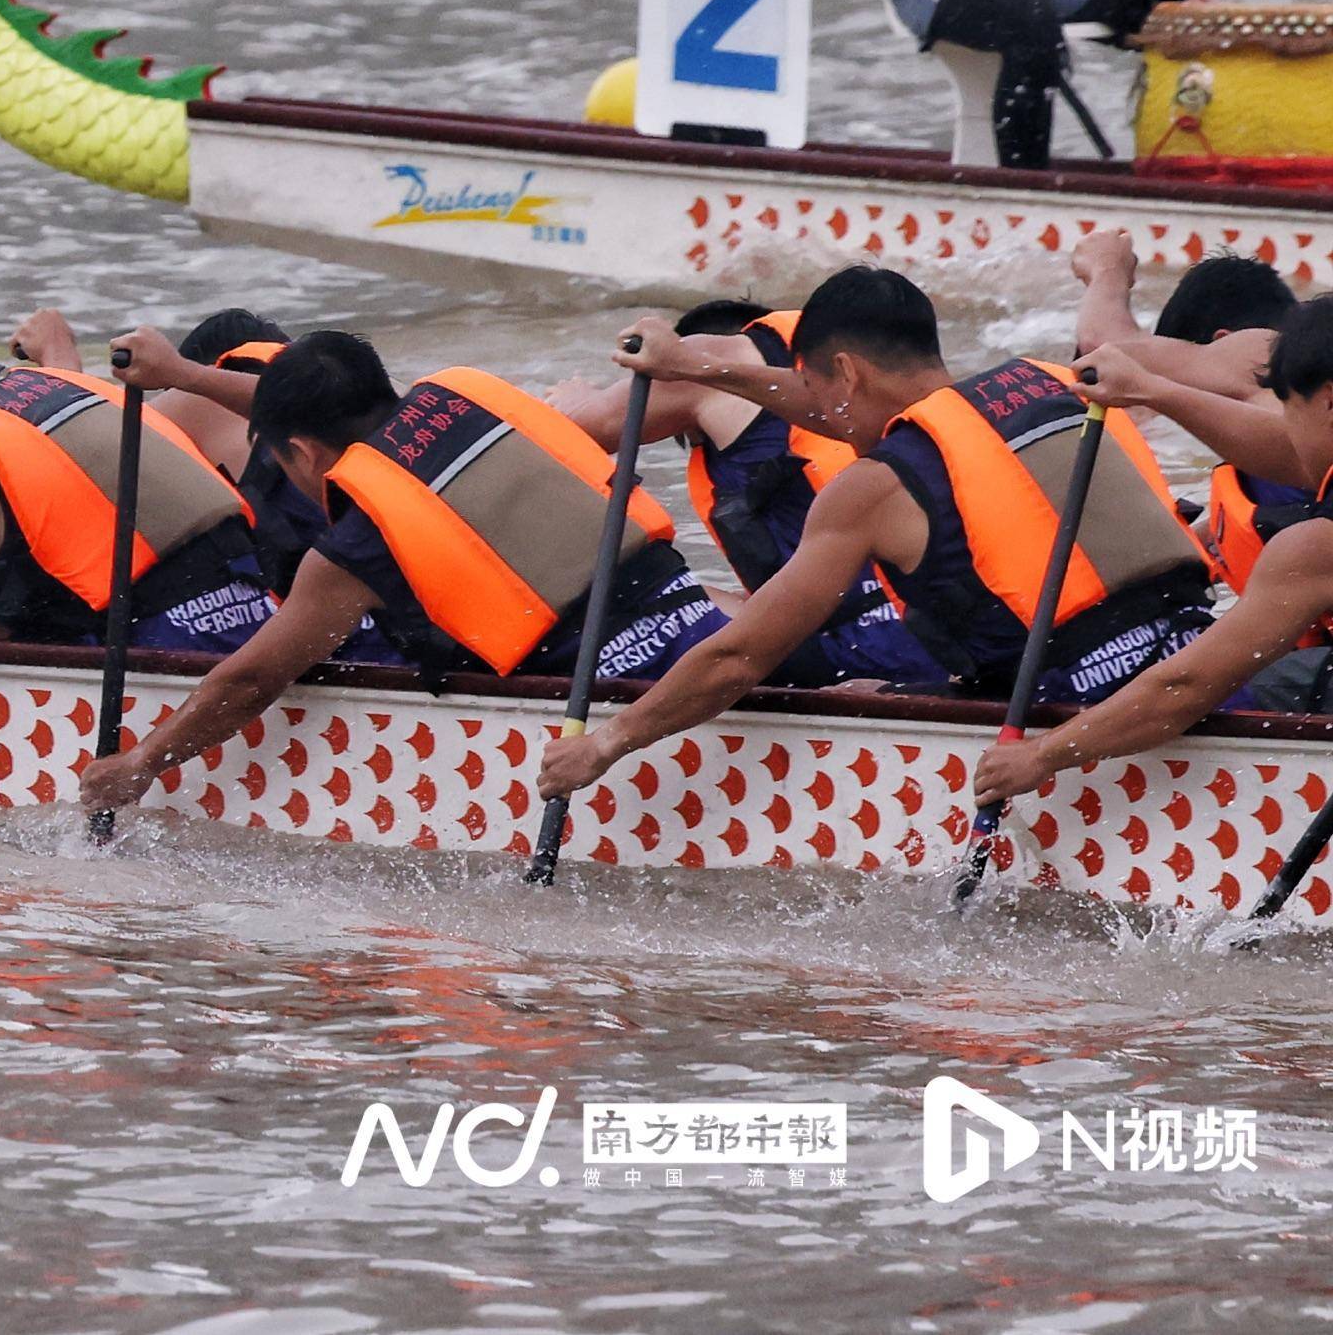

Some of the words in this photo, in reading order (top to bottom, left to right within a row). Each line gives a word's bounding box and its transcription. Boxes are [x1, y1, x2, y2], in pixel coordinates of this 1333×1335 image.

[974, 365, 1036, 401] 广州市
[383, 390, 440, 446] 广州市
[397, 398, 472, 467] 龙舟协会
